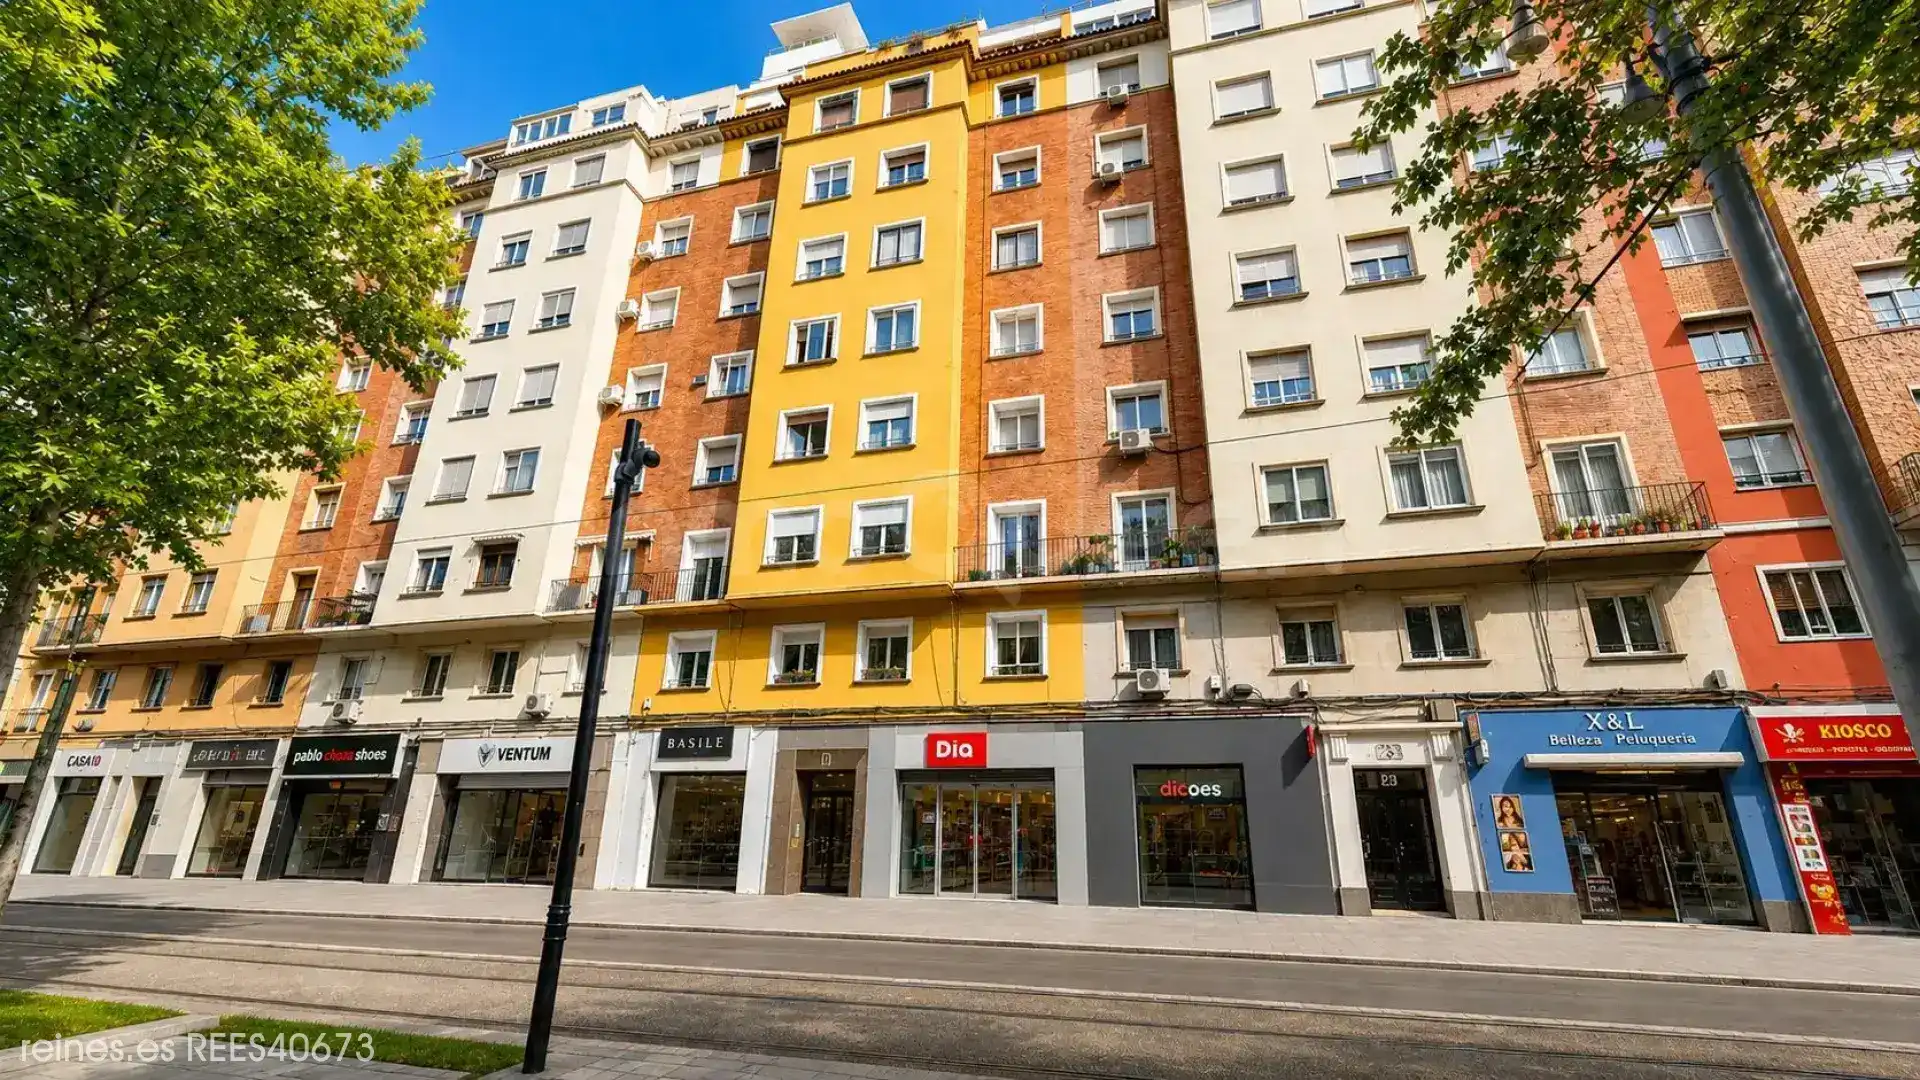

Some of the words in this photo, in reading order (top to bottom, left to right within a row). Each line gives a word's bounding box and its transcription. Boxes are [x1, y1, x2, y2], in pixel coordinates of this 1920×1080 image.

[1819, 723, 1892, 739] KIOSCO
[667, 736, 724, 749] BASILE
[1549, 734, 1602, 746] Belleza
[292, 748, 323, 766] pablo
[355, 748, 387, 761] shoes
[497, 746, 551, 761] VENTUM
[936, 740, 973, 758] Dia
[1160, 780, 1222, 797] dicoes
